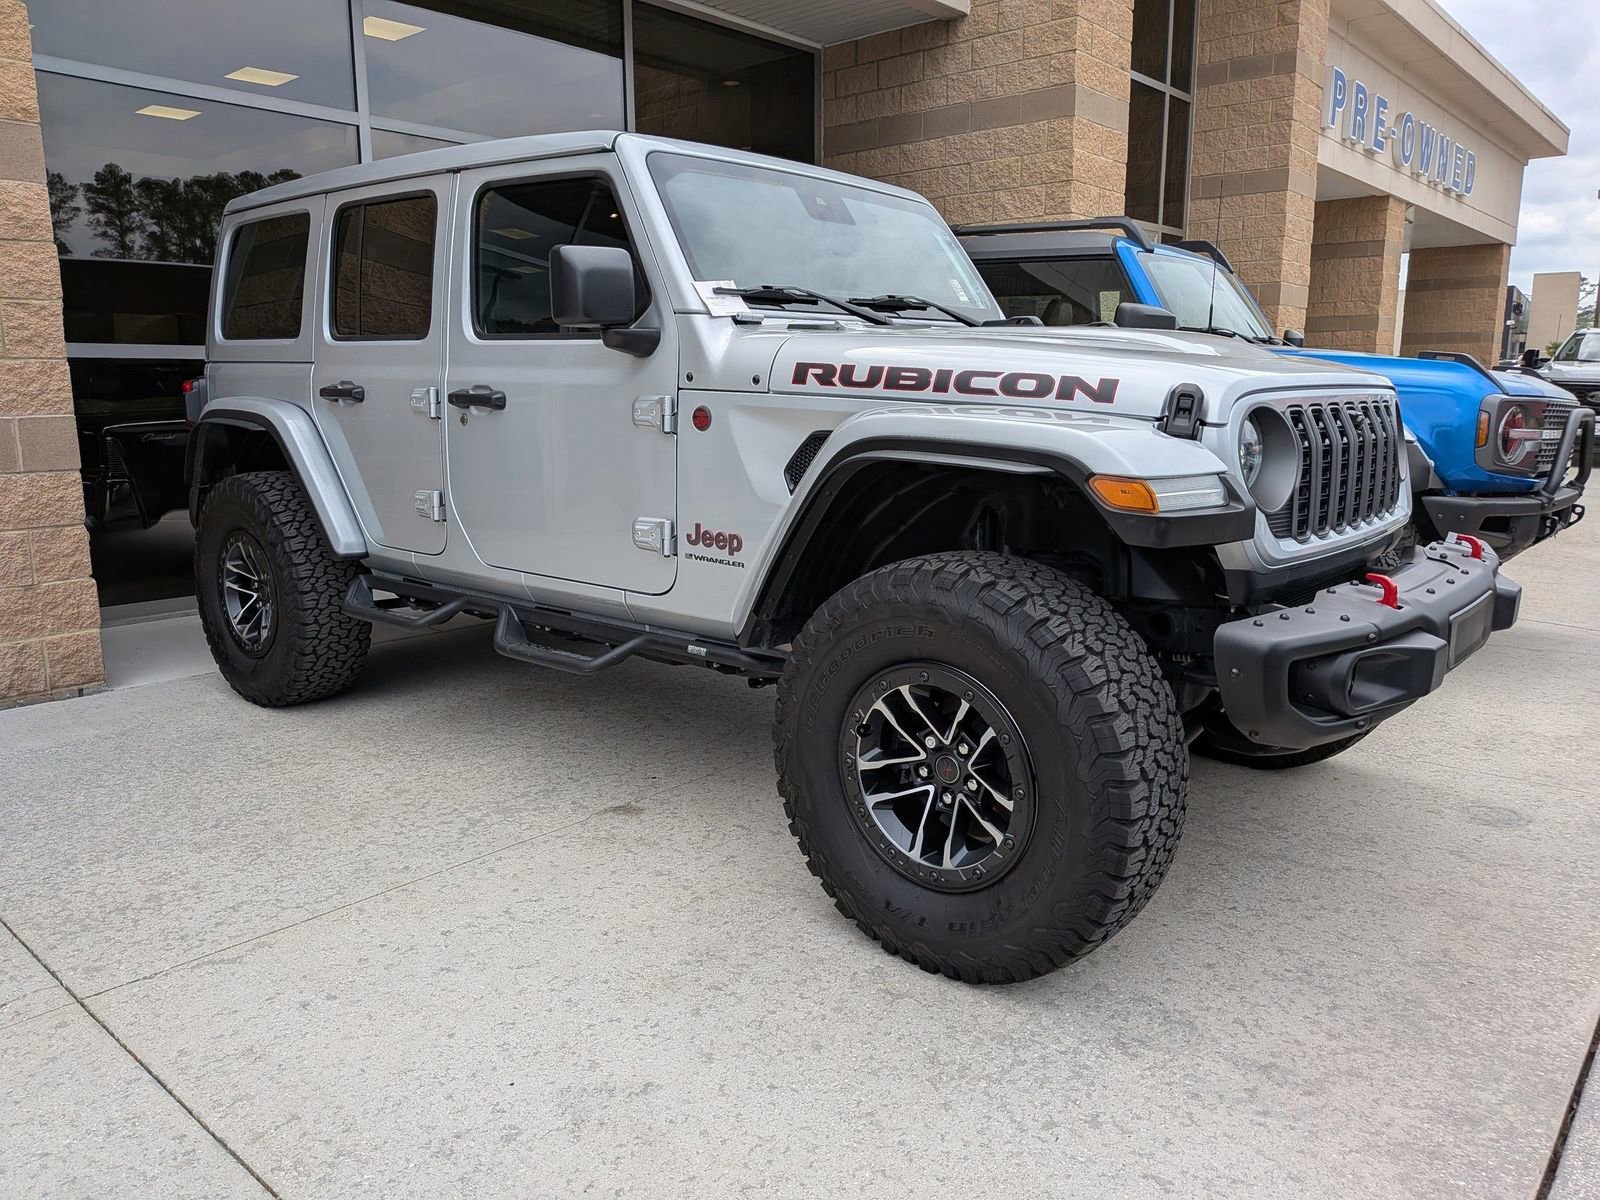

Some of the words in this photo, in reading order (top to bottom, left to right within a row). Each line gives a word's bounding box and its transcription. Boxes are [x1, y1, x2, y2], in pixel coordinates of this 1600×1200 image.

[1322, 66, 1477, 197] PRE-OWNED
[791, 361, 1121, 404] RUBICON
[686, 522, 743, 556] Jeep
[693, 554, 745, 568] WRANGLER
[804, 624, 936, 734] BFGoodrich
[947, 799, 1068, 936] All-Teain
